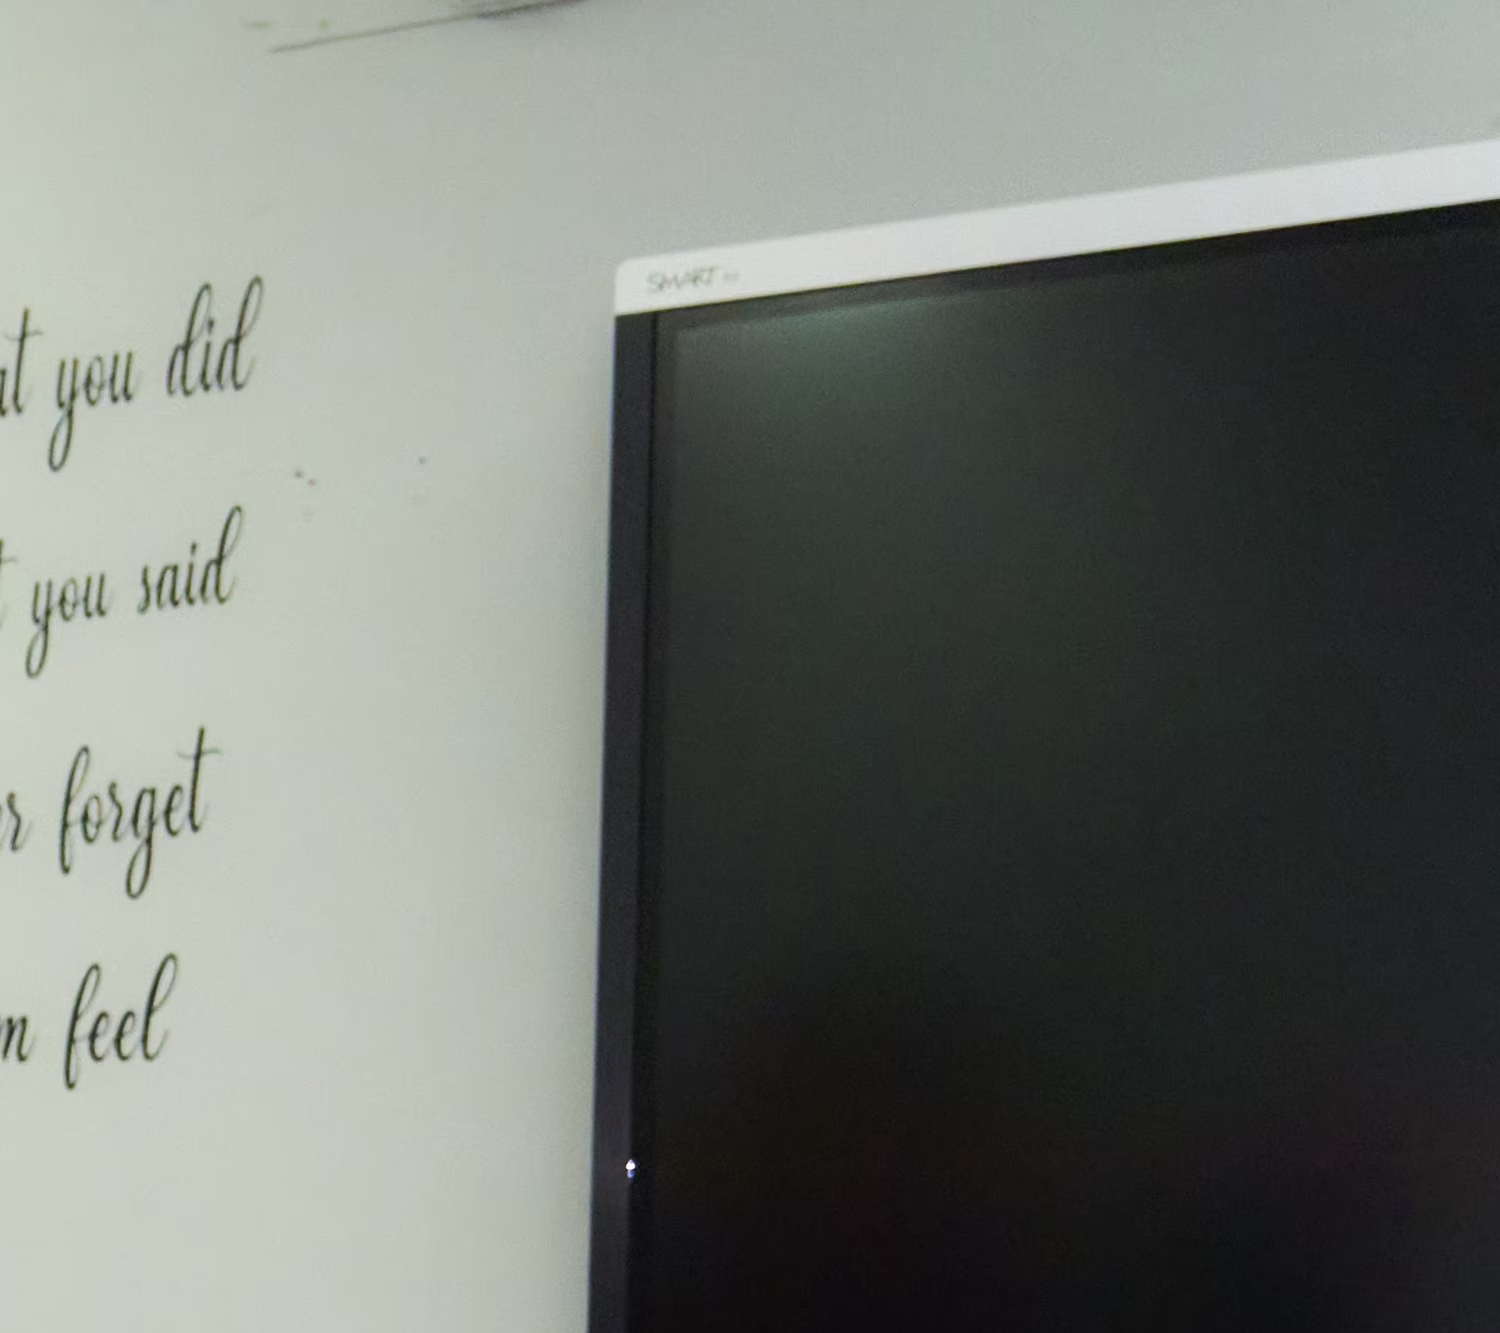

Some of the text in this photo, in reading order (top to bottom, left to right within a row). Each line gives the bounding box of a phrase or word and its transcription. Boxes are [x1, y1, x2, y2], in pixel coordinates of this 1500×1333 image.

[49, 350, 138, 472] you
[167, 276, 264, 397] did
[26, 573, 108, 678] you
[137, 505, 243, 614] said
[60, 726, 222, 899] forget
[64, 953, 178, 1090] feel
